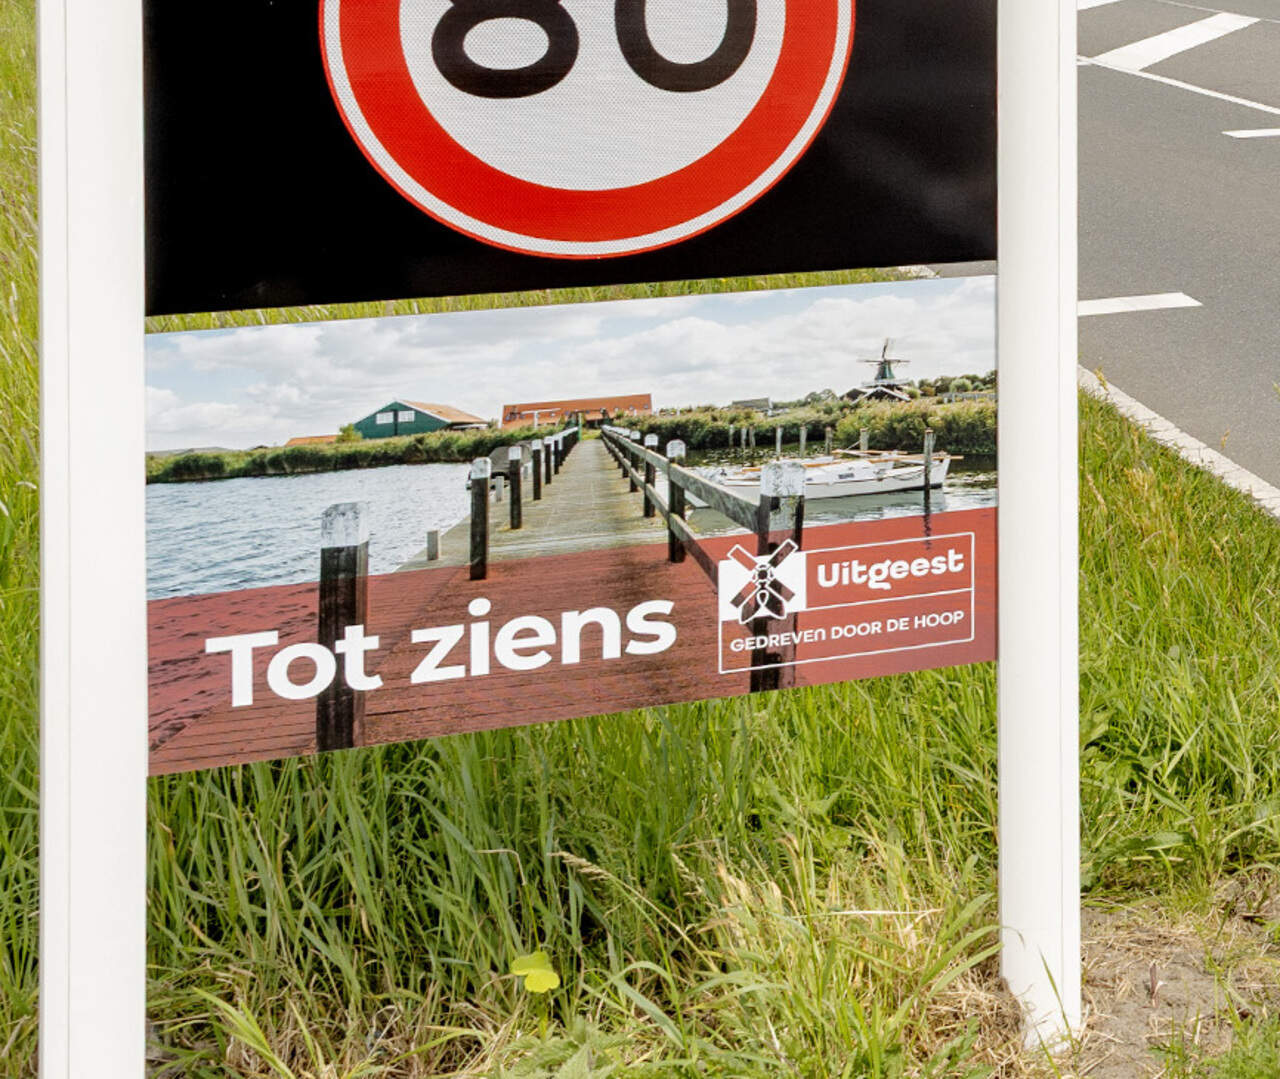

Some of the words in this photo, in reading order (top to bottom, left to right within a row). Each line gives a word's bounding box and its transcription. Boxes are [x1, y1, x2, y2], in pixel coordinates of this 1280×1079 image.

[817, 549, 964, 590] Uitgeest
[730, 628, 826, 652] GEDREVEN
[831, 621, 882, 639] DOOR
[886, 617, 910, 632] DE
[914, 610, 965, 629] HOOP
[205, 625, 383, 707] Tot
[411, 598, 676, 685] ziens
